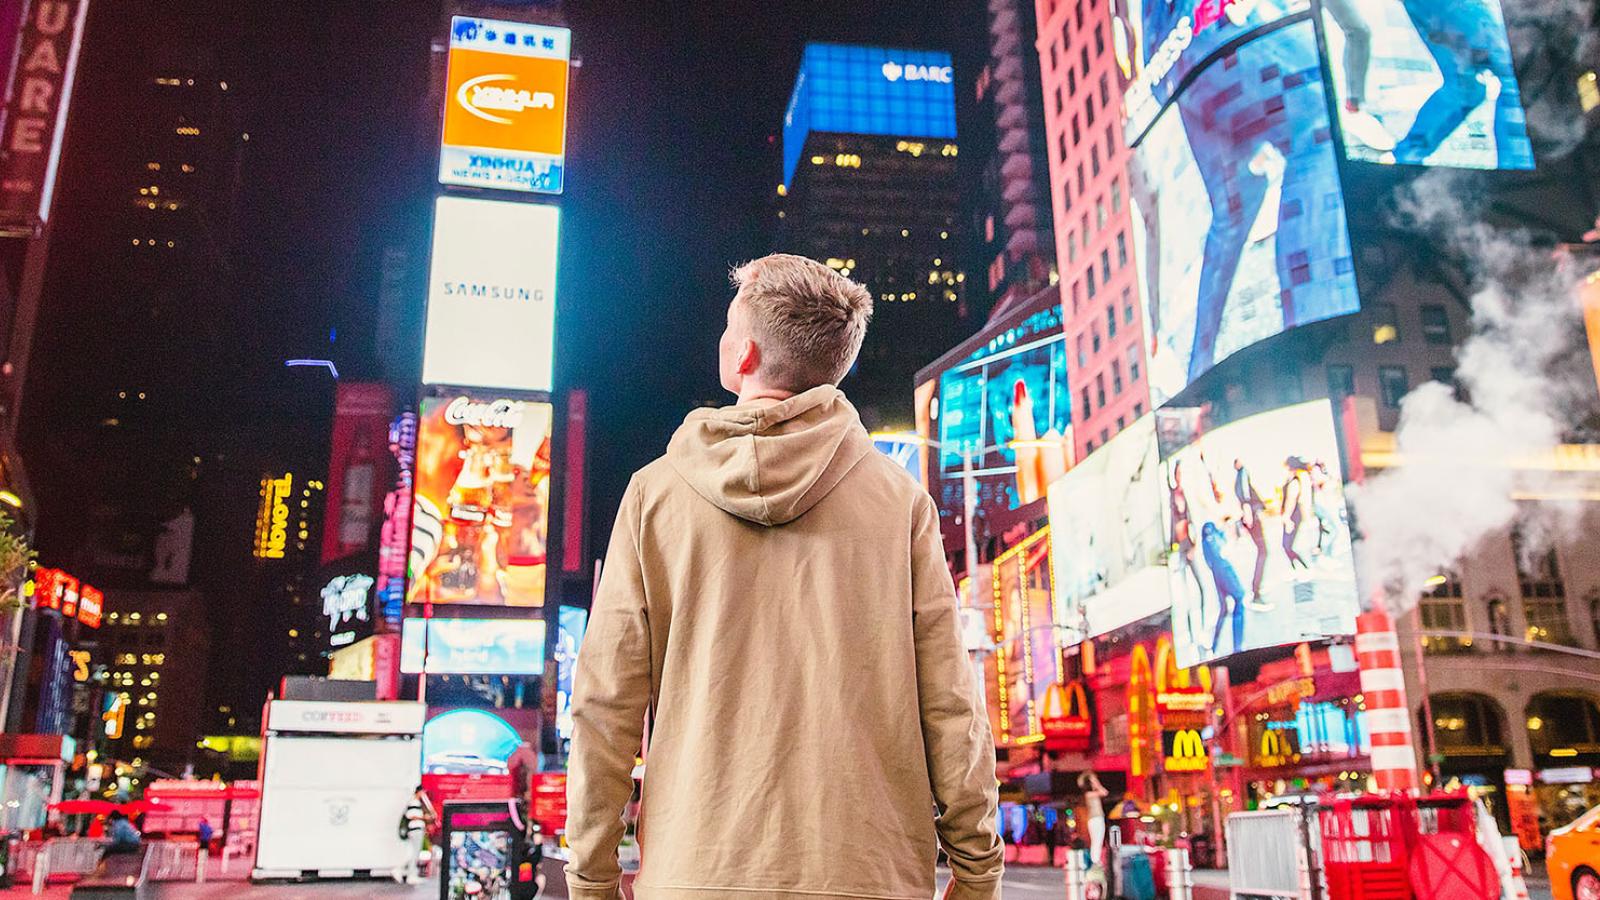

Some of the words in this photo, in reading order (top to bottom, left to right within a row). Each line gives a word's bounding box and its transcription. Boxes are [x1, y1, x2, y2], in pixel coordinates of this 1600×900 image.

[469, 155, 536, 175] XINHUA
[443, 281, 544, 302] SAMSUNG
[266, 472, 293, 558] NOVOTEL
